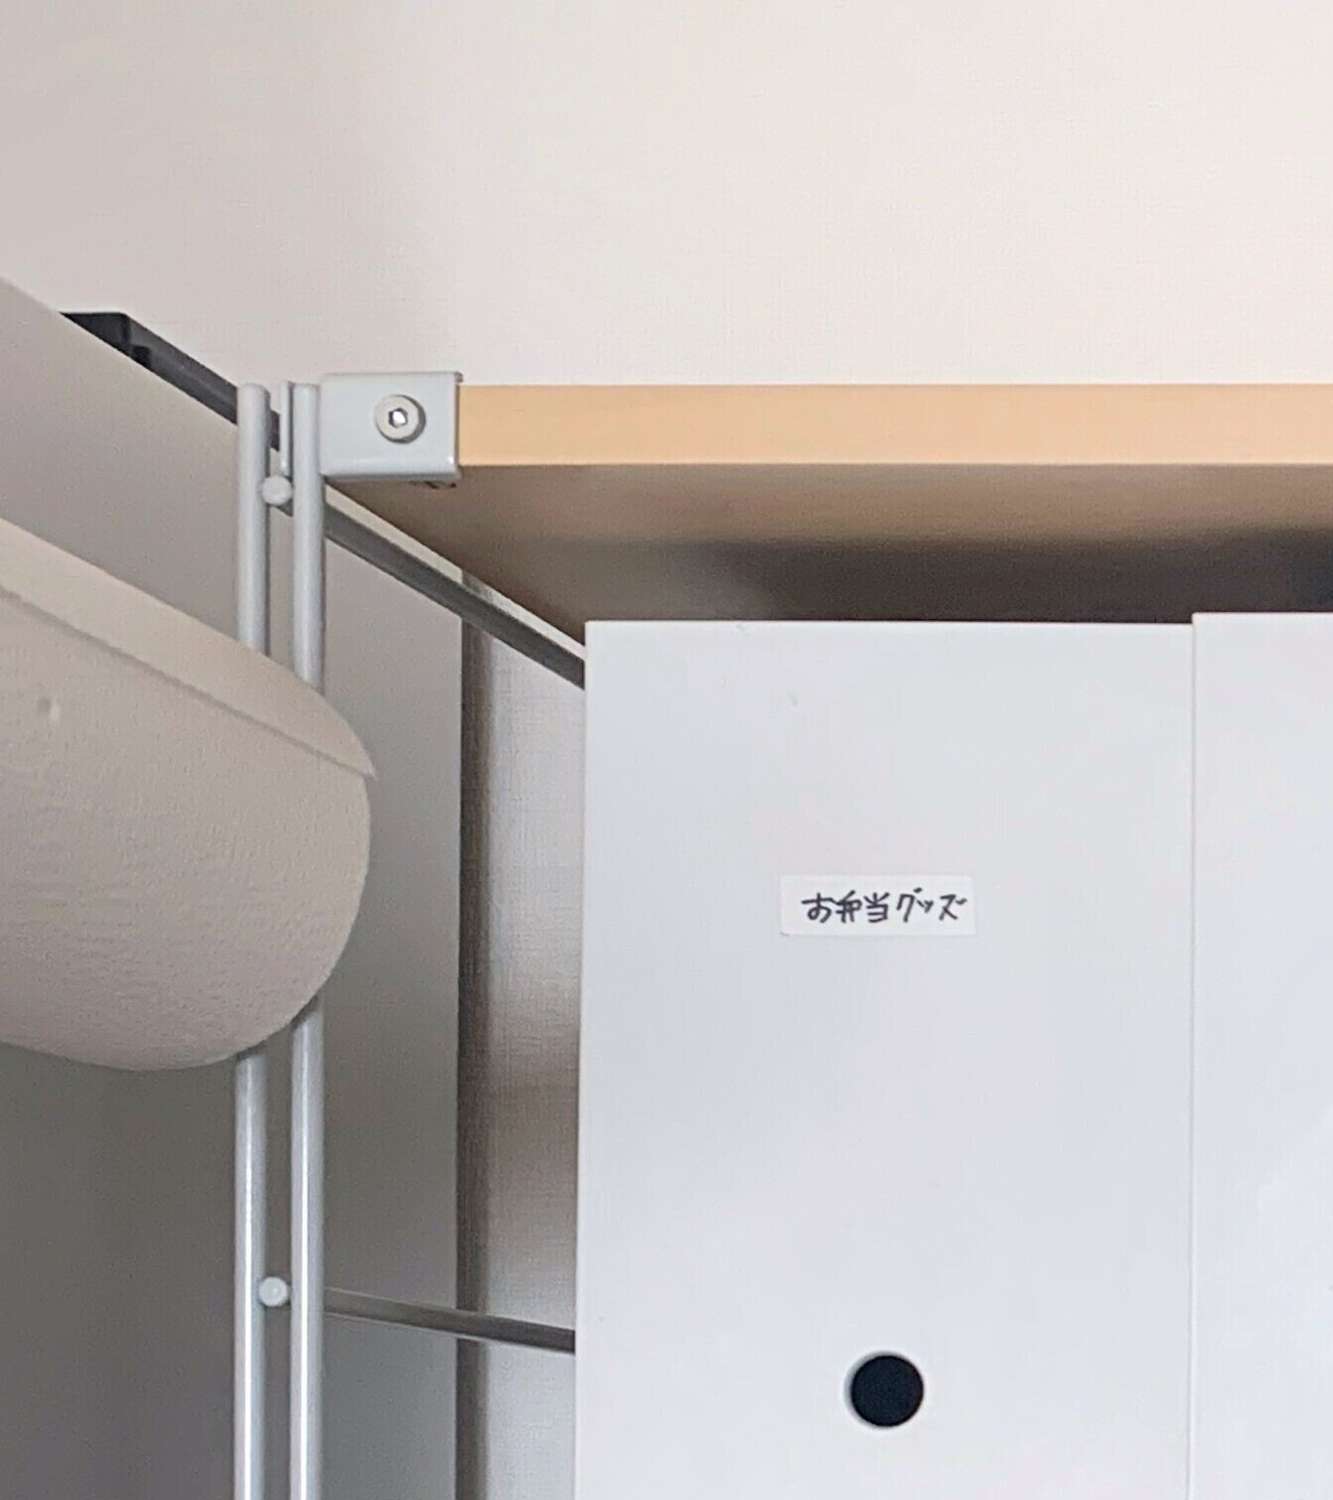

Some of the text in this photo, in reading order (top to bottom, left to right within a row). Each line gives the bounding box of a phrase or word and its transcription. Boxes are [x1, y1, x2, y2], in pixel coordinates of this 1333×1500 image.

[800, 886, 968, 924] お弁当グッズ
